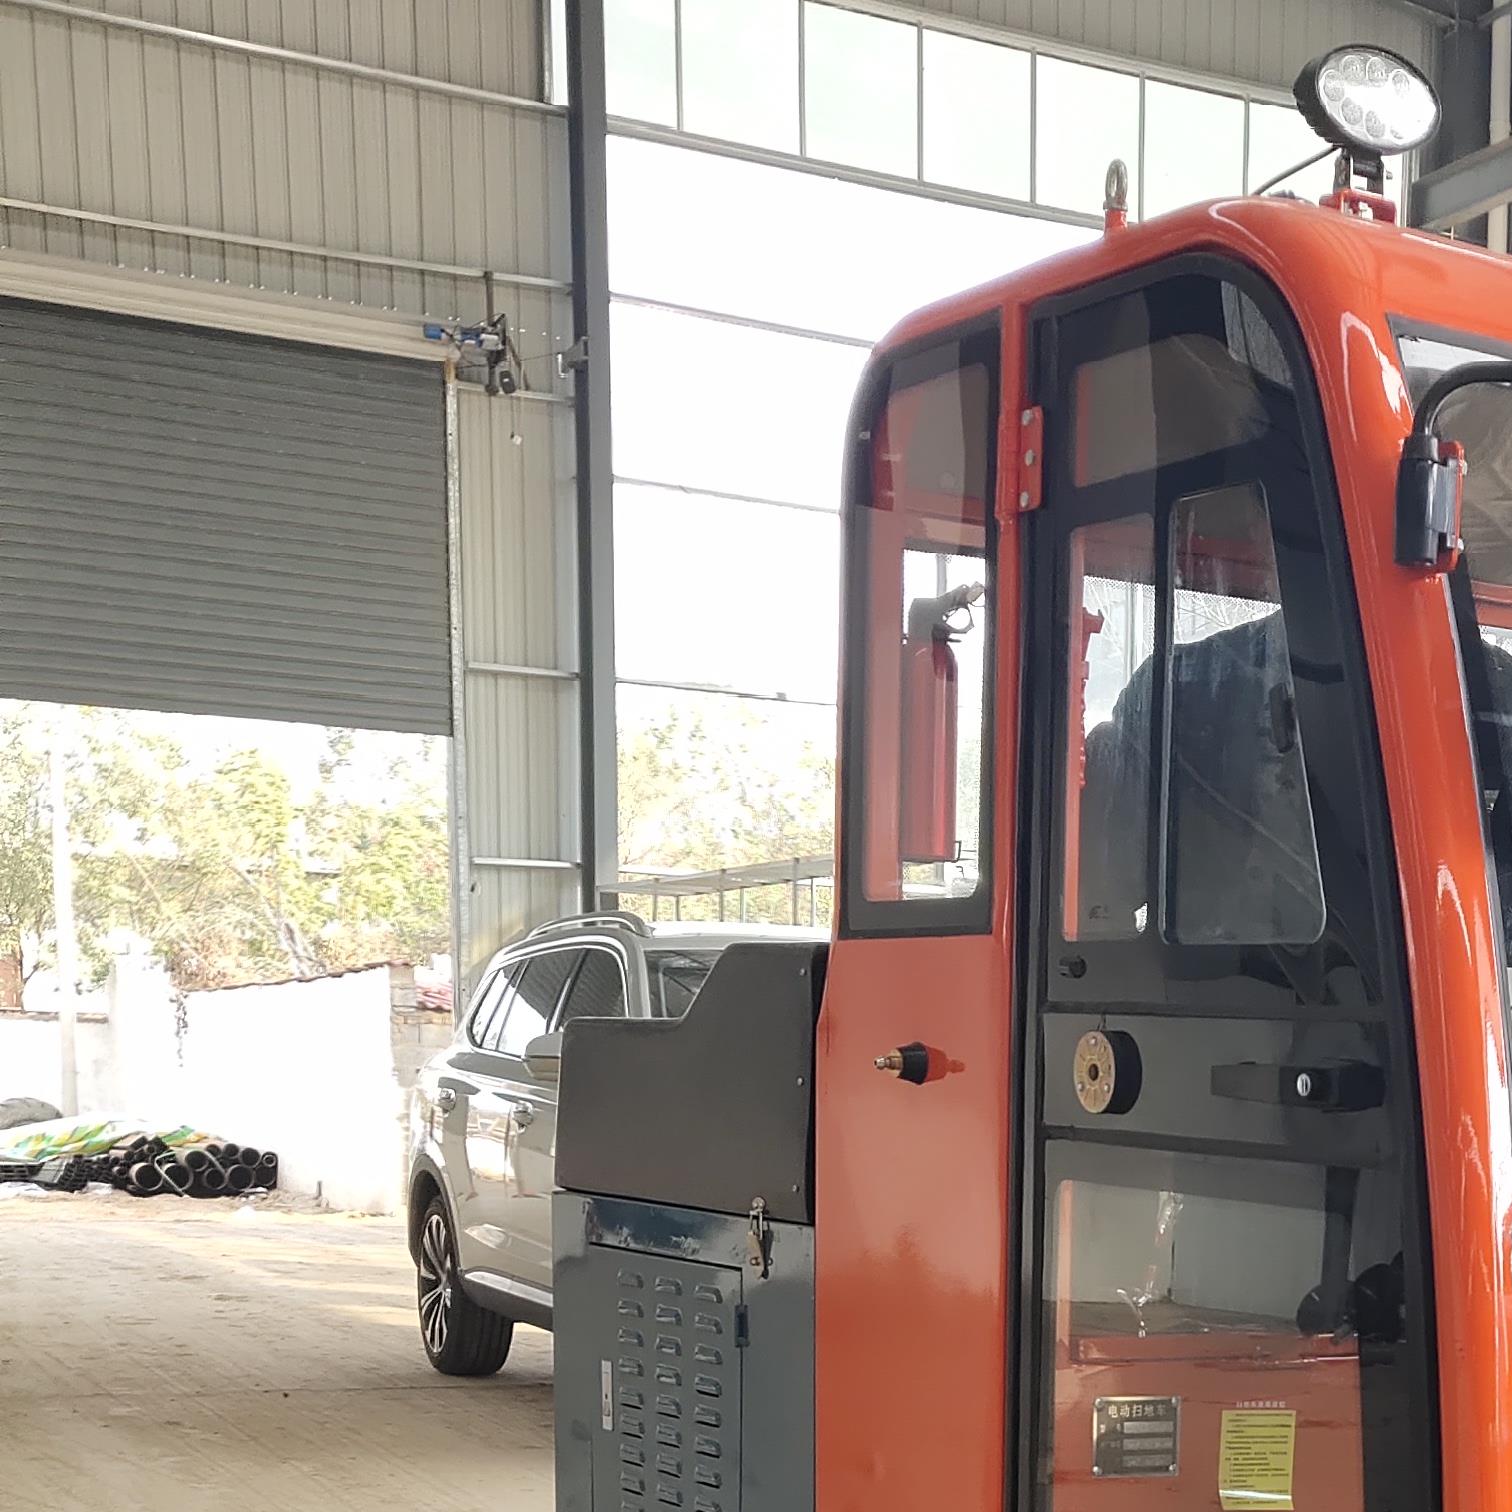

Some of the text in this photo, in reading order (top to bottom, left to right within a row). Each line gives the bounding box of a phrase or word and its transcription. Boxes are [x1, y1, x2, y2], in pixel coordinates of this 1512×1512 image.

[1108, 1404, 1167, 1418] 电动扫地车
